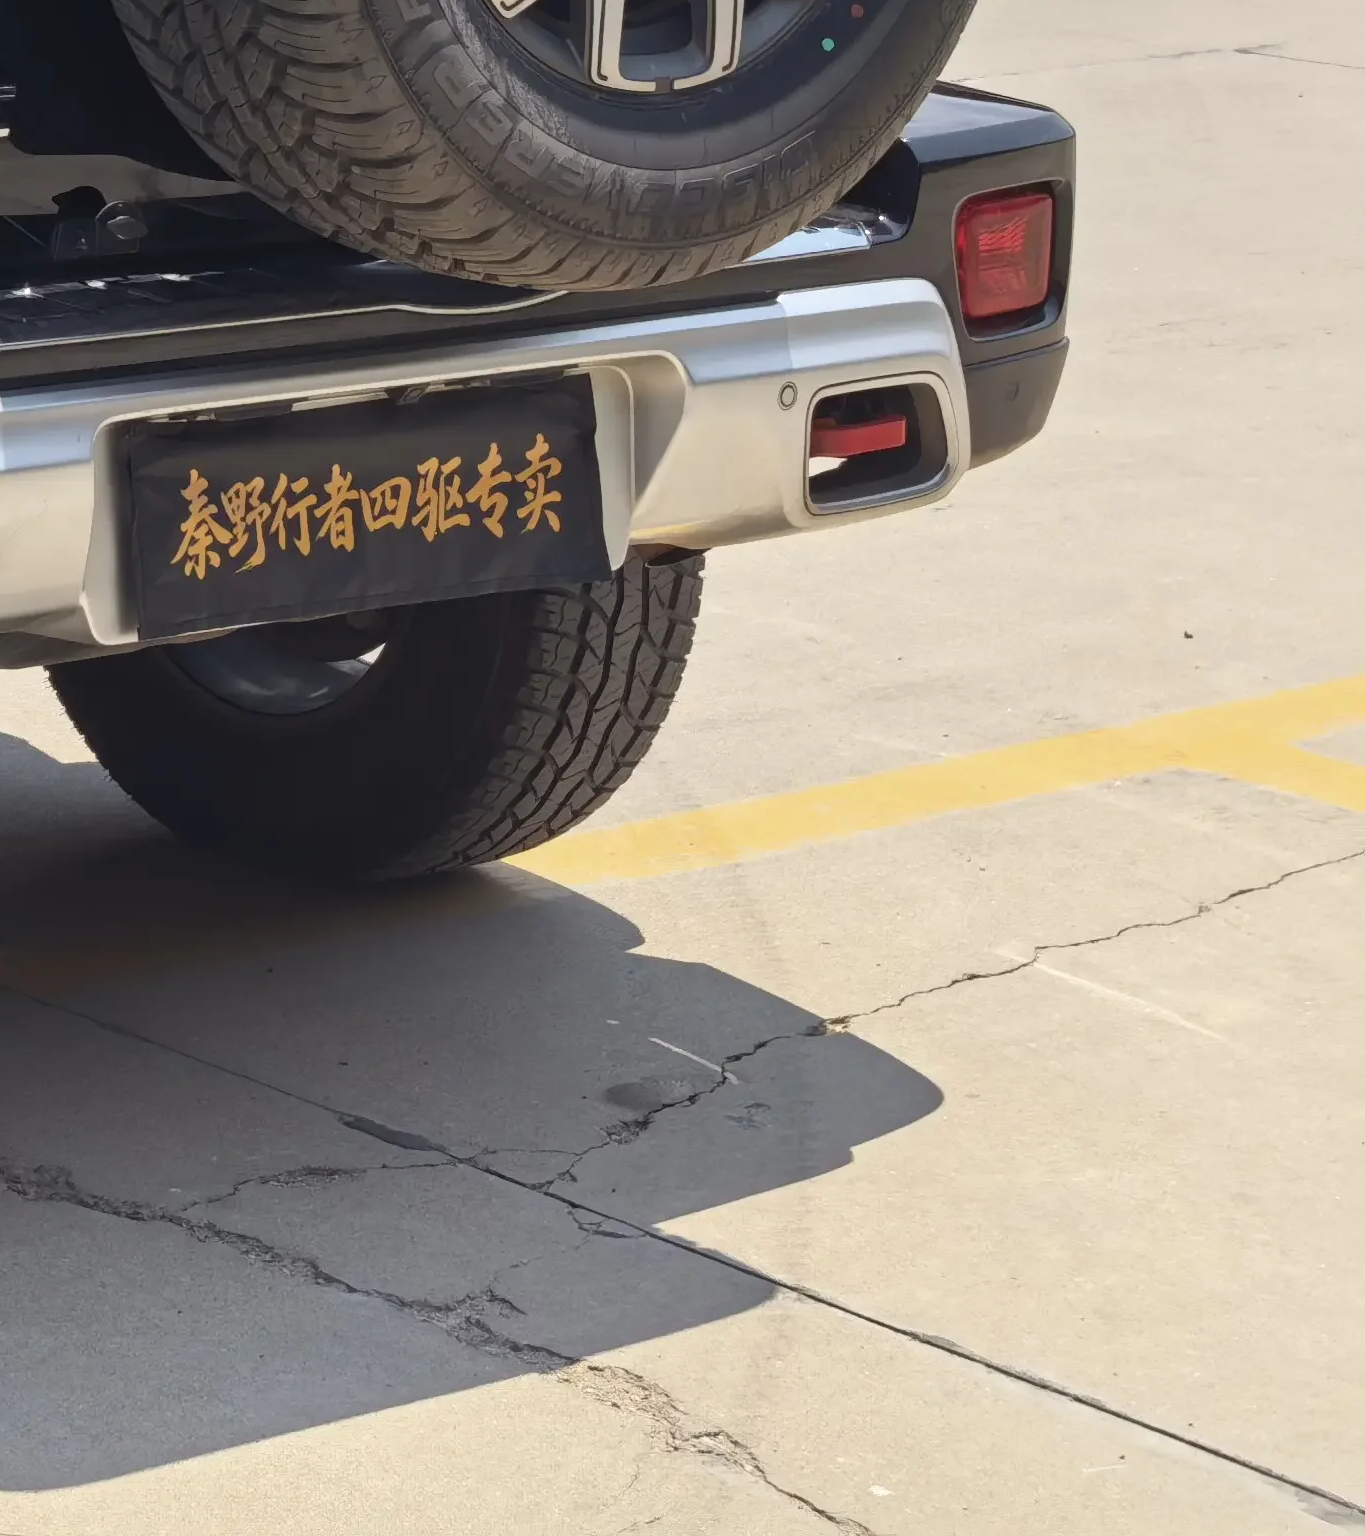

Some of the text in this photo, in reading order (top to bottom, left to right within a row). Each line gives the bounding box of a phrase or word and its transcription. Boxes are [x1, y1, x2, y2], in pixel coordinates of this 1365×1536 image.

[170, 433, 563, 580] 秦野行者四驱专卖
